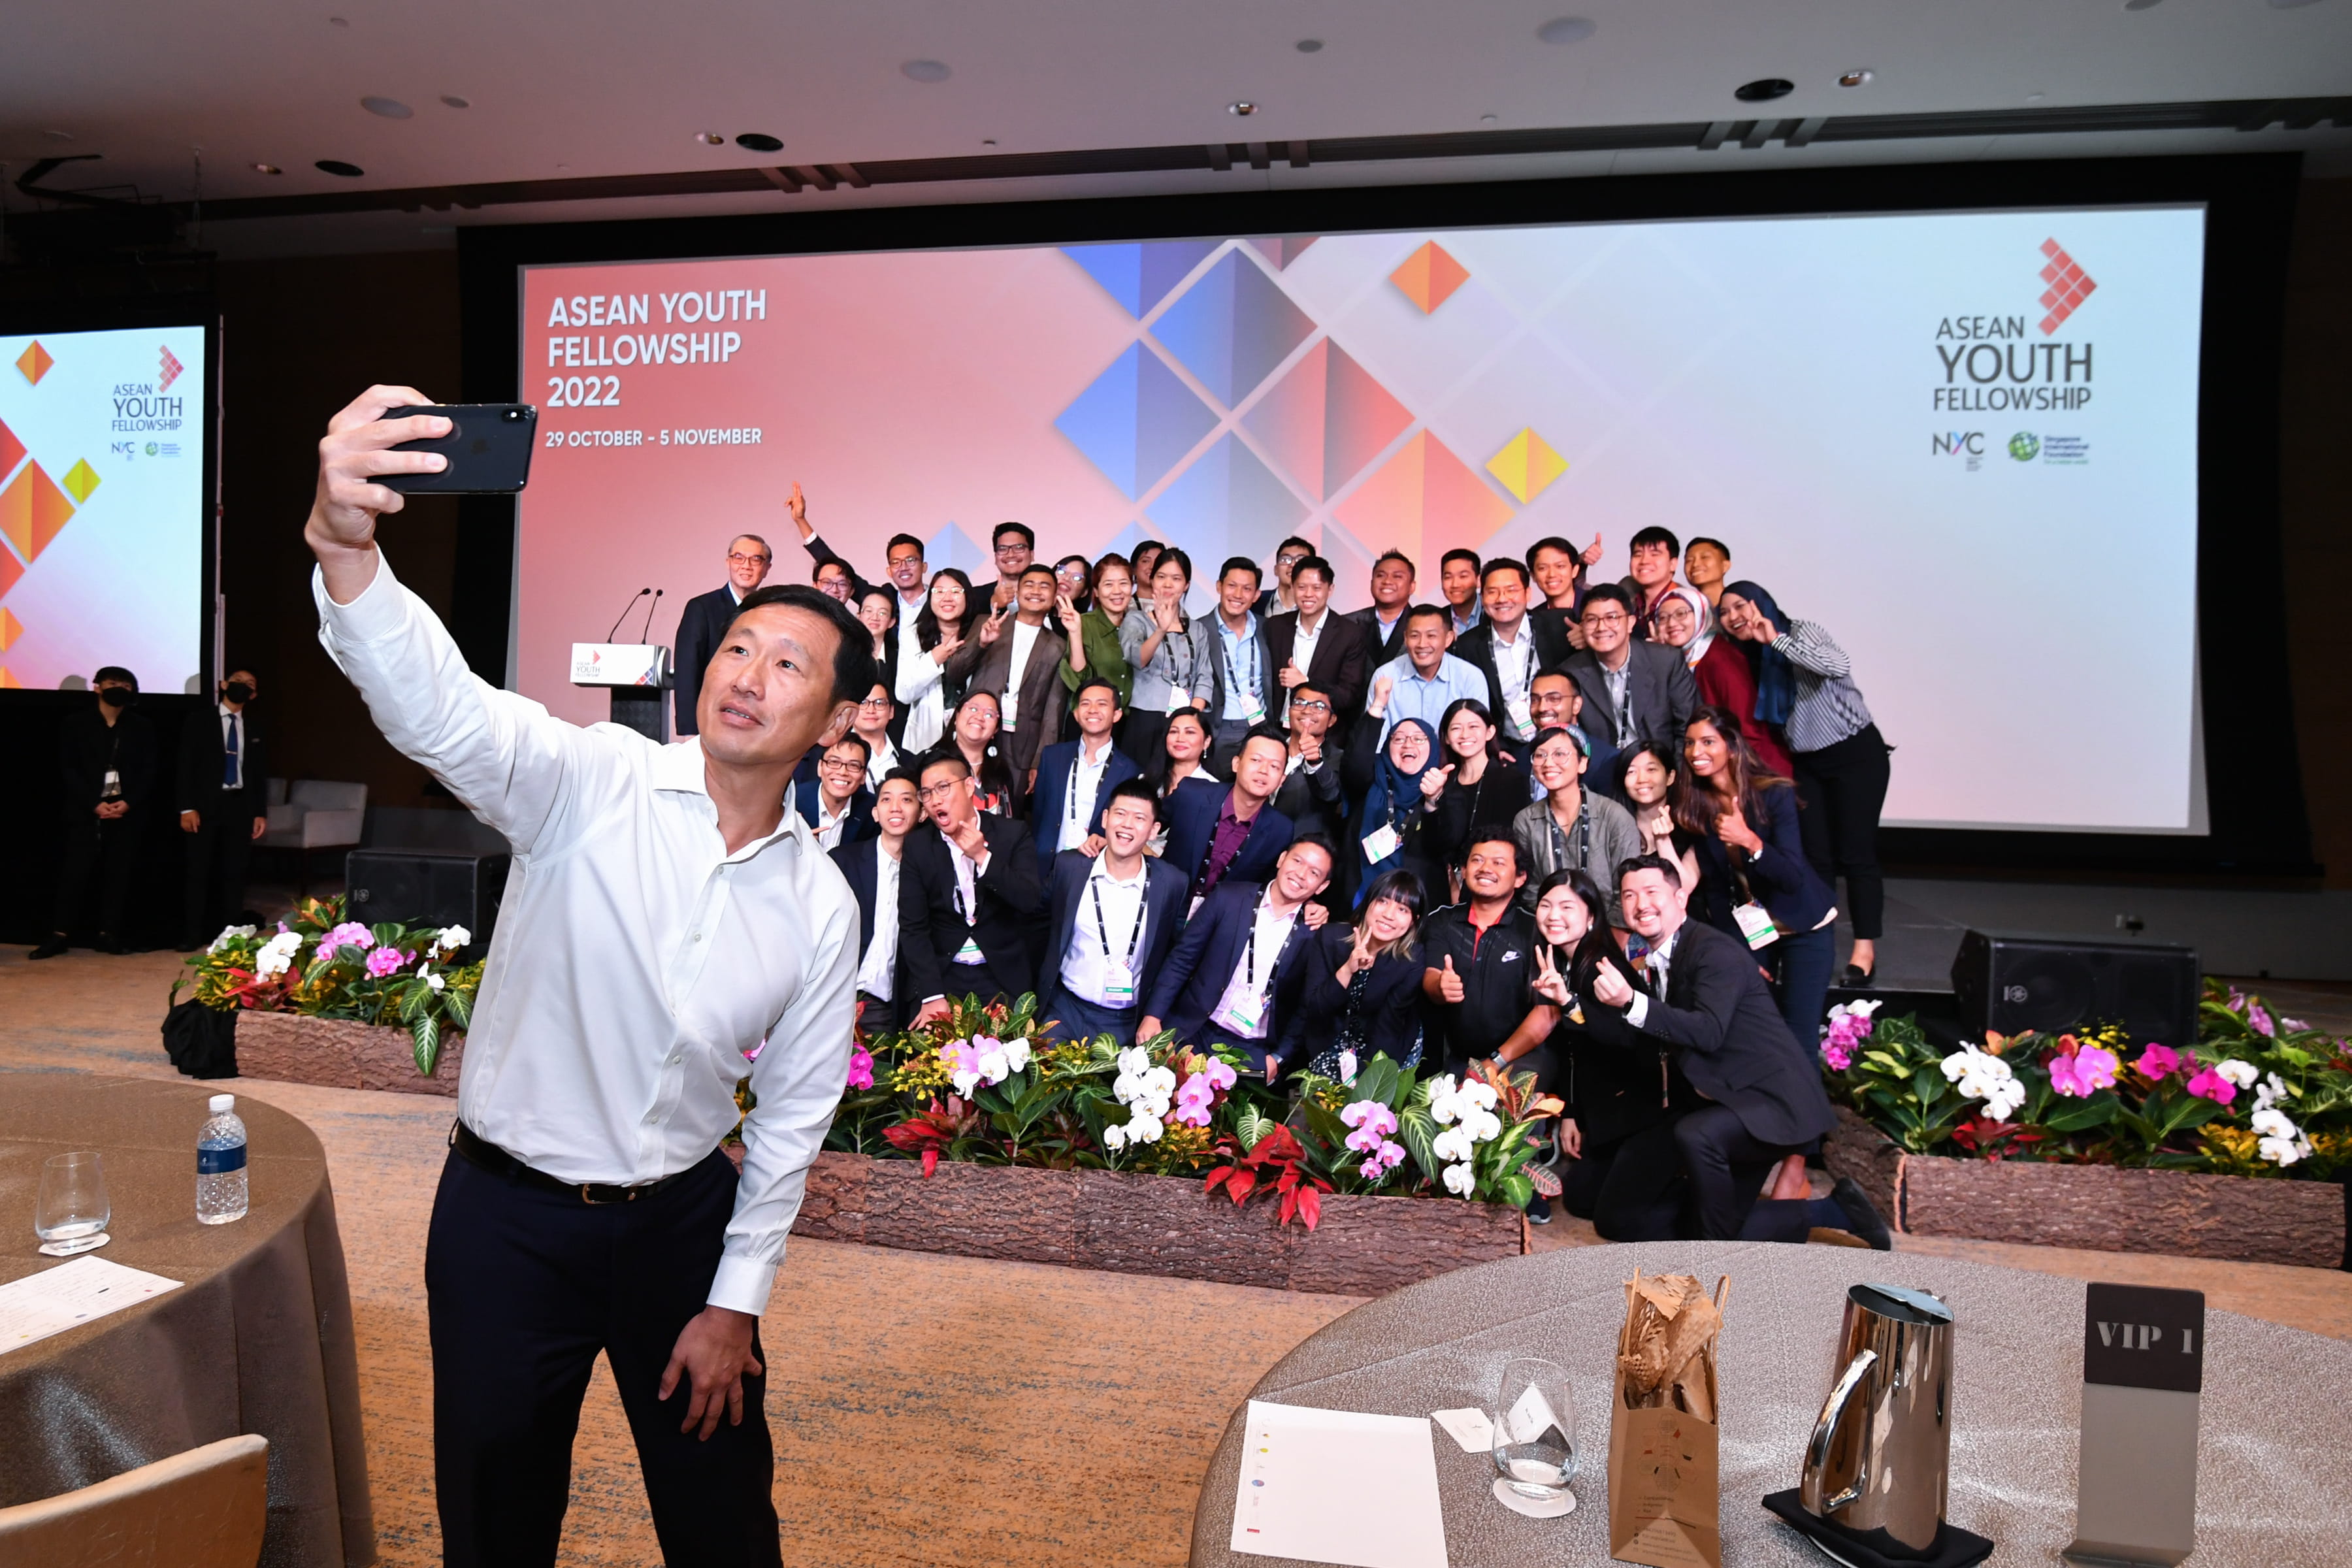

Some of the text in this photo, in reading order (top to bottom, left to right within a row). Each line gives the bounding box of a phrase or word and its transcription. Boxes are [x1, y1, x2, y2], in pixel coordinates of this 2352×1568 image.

[548, 289, 766, 327] ASEAN YOUTH
[1936, 316, 2025, 340] ASEAN
[548, 331, 742, 367] FELLOWSHIP
[1935, 343, 2093, 384] YOUTH
[113, 384, 153, 396] ASEAN
[547, 375, 621, 407] 2022
[1934, 387, 2092, 411] FELLOWSHIP
[113, 397, 182, 418] YOUTH
[112, 419, 182, 432] FELLOWSHIP
[546, 431, 564, 447] 29
[568, 430, 642, 446] OCTOBER
[660, 429, 670, 446] 5
[675, 428, 762, 445] NOVEMBER
[112, 442, 135, 453] NYC
[1933, 431, 1985, 455] NYC
[2096, 1321, 2193, 1354] VIP 1
